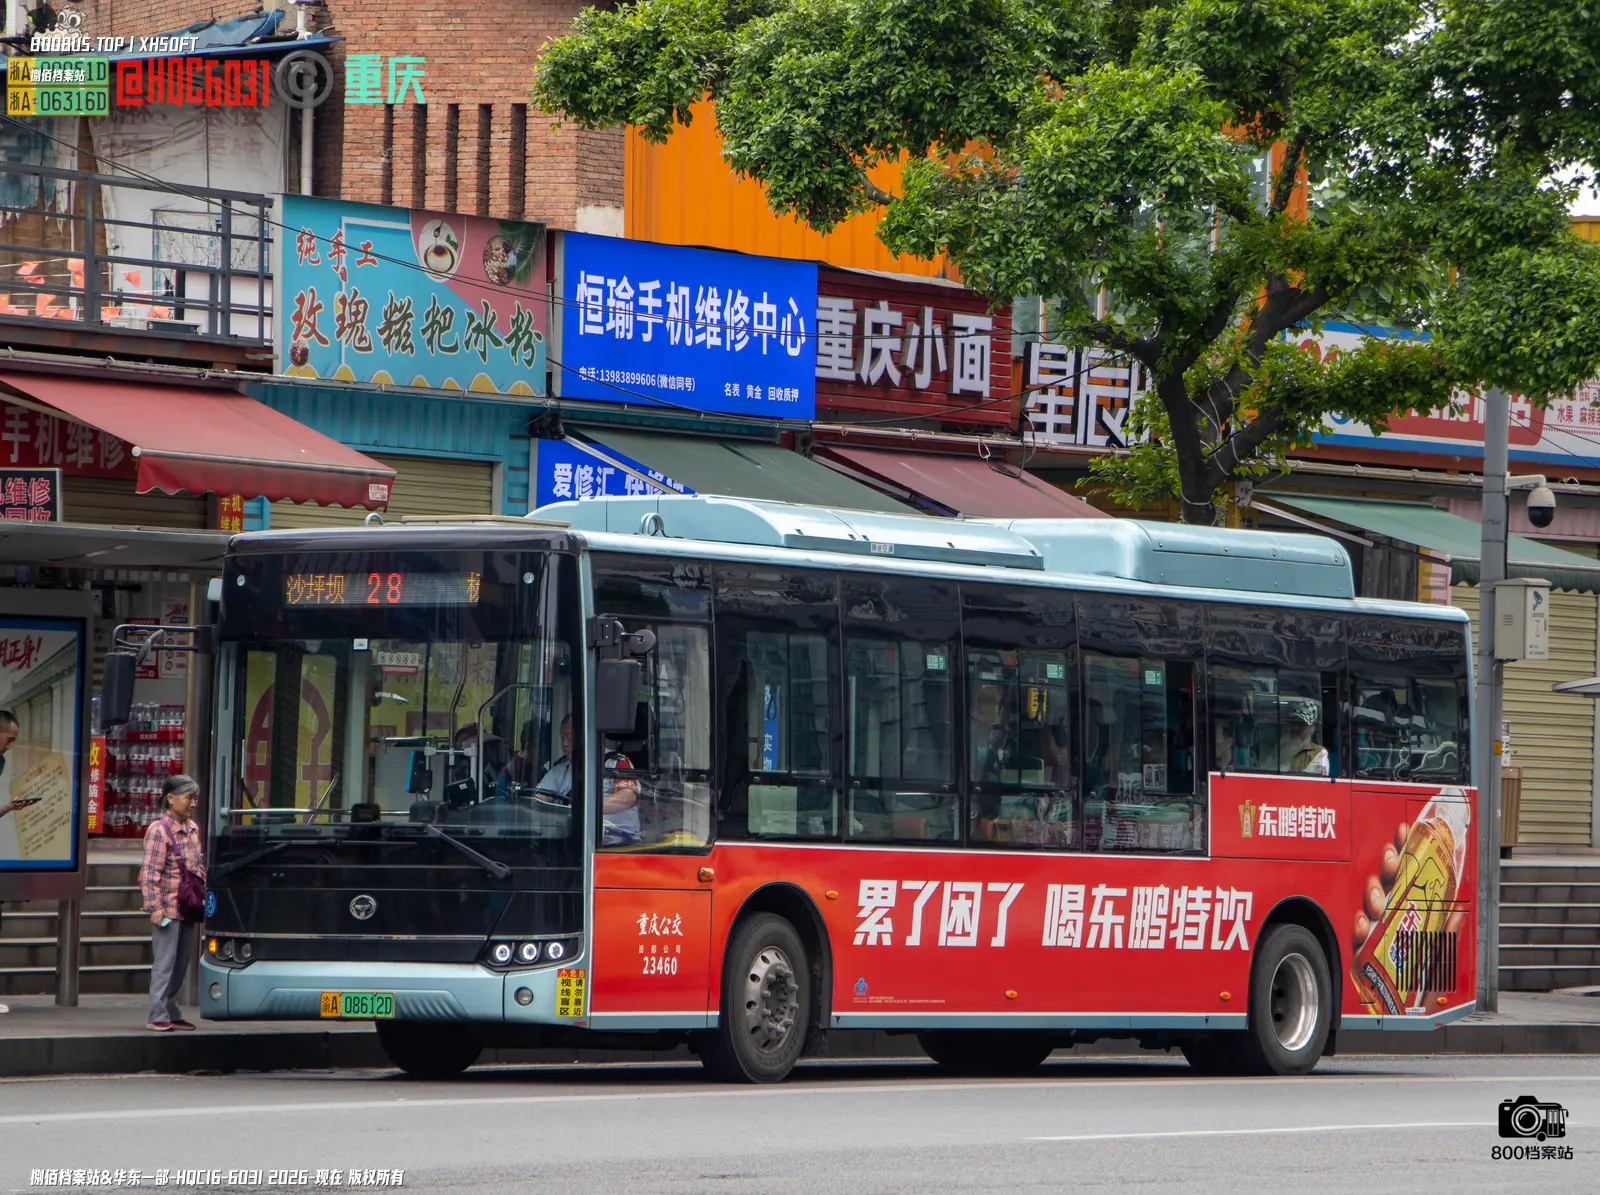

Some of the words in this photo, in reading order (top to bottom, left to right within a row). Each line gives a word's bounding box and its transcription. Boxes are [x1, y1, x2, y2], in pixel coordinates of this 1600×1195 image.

[295, 226, 378, 274] 纯手工
[291, 286, 543, 369] 玫瑰糍粑冰粉
[575, 270, 806, 357] 恒瑜手机维修中心
[816, 296, 993, 398] 重庆小面
[746, 384, 762, 400] 黄金
[1557, 404, 1574, 424] 水果
[2, 406, 125, 470] 手机维修
[0, 477, 51, 506] 维修
[552, 463, 615, 499] 爱修汇
[221, 494, 241, 512] 手机
[286, 573, 345, 604] 沙坪坝
[367, 573, 401, 604] 28
[1258, 803, 1336, 839] 东鹏特饮
[636, 913, 683, 936] 重庆公交
[853, 879, 1025, 947] 累了困了
[1042, 883, 1253, 951] 喝东鹏特饮
[642, 956, 677, 975] 23460
